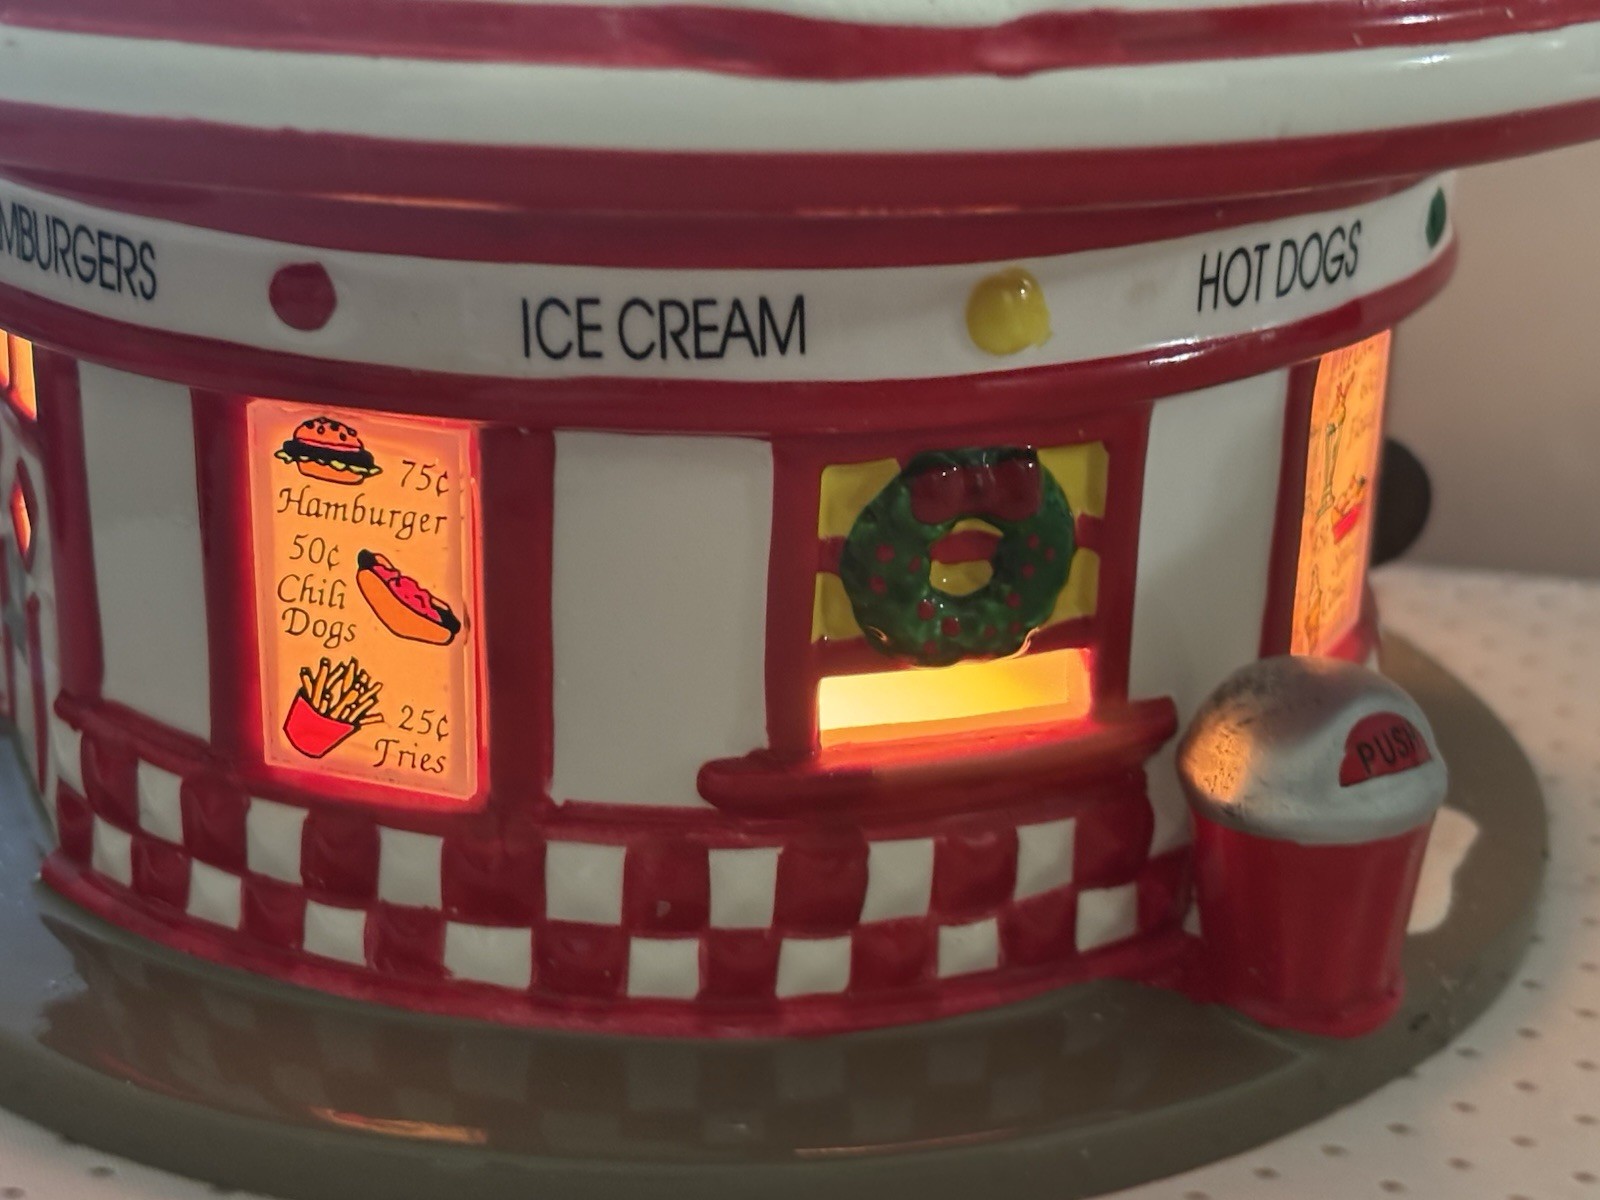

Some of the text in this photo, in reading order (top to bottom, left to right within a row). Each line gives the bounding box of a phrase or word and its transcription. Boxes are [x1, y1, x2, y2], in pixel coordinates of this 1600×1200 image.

[1197, 218, 1362, 313] HOT DOGS
[521, 293, 806, 360] ICE CREAM
[400, 459, 450, 497] 75¢
[277, 485, 448, 541] Hamburger
[288, 533, 340, 571] 50¢
[277, 573, 347, 610] Chili
[281, 606, 357, 649] Dogs
[398, 704, 449, 742] 25¢
